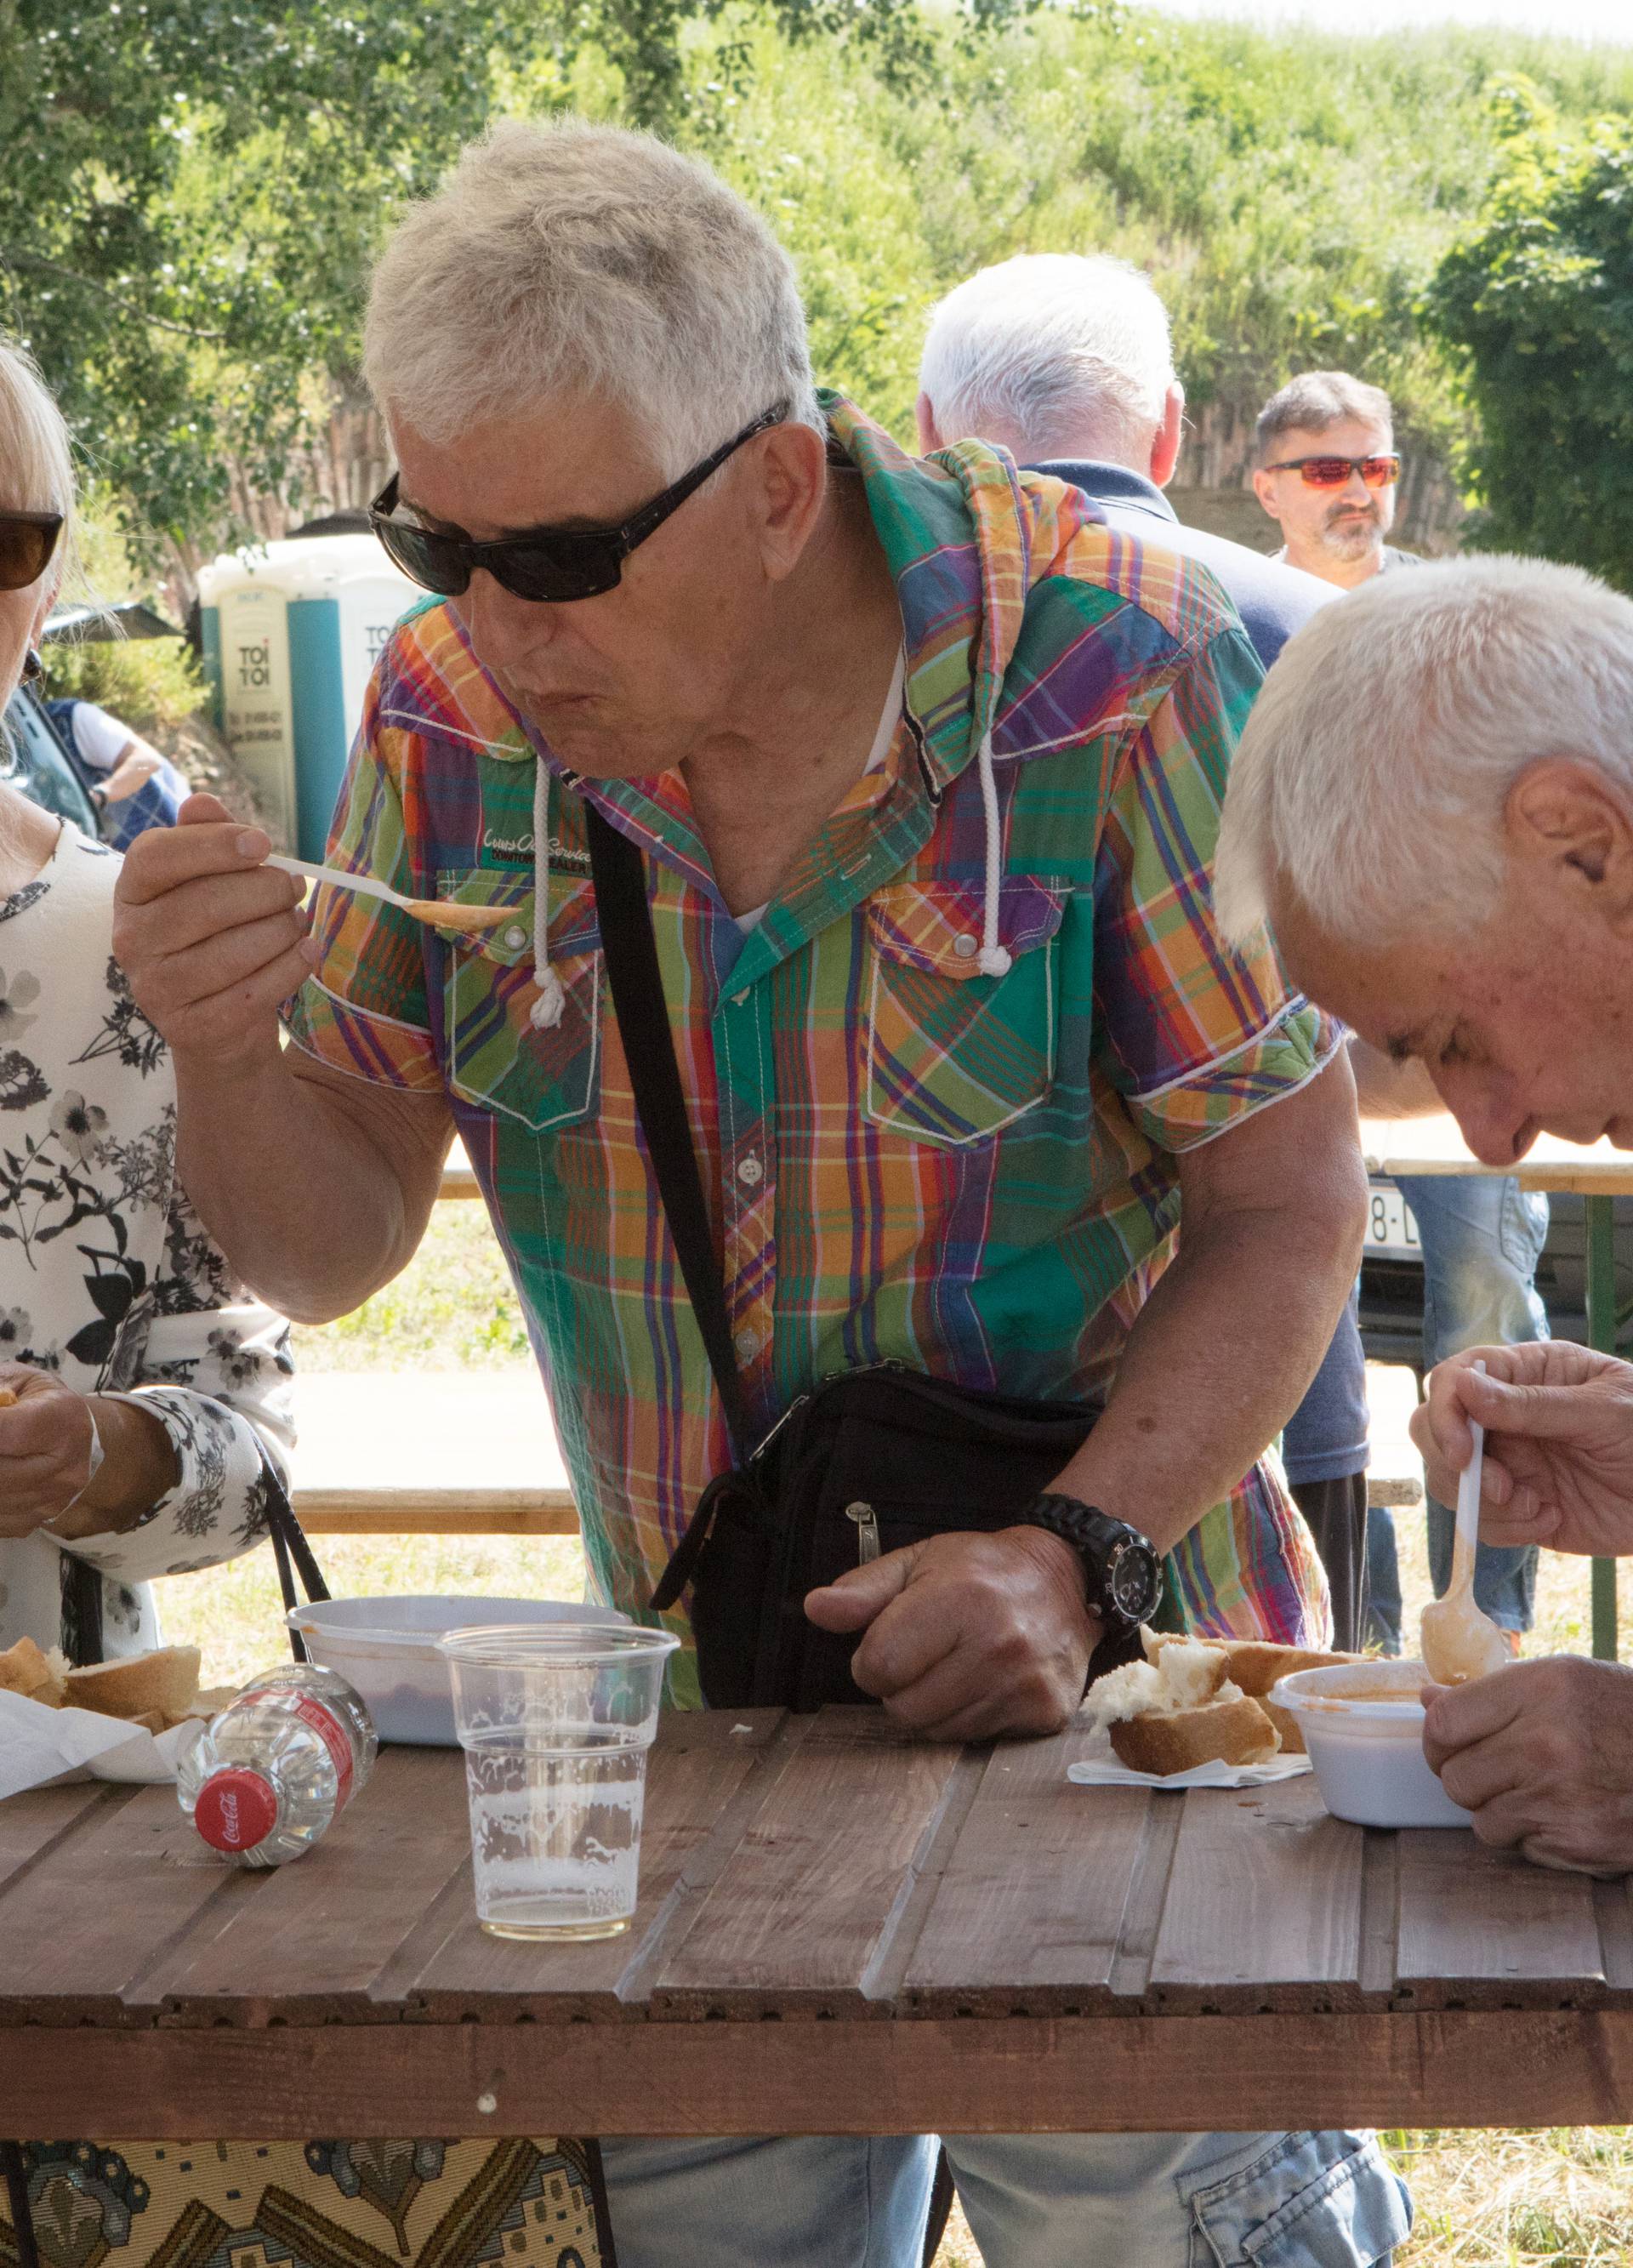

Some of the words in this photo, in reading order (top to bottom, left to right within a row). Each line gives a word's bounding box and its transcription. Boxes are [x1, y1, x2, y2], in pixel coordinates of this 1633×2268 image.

[366, 626, 390, 645] TO
[239, 639, 269, 664] TOI
[239, 669, 270, 686] TOI
[548, 837, 592, 863] Service
[492, 849, 536, 865] DOWNTOW
[548, 856, 587, 874] EALER
[1113, 1542, 1124, 1556] 30
